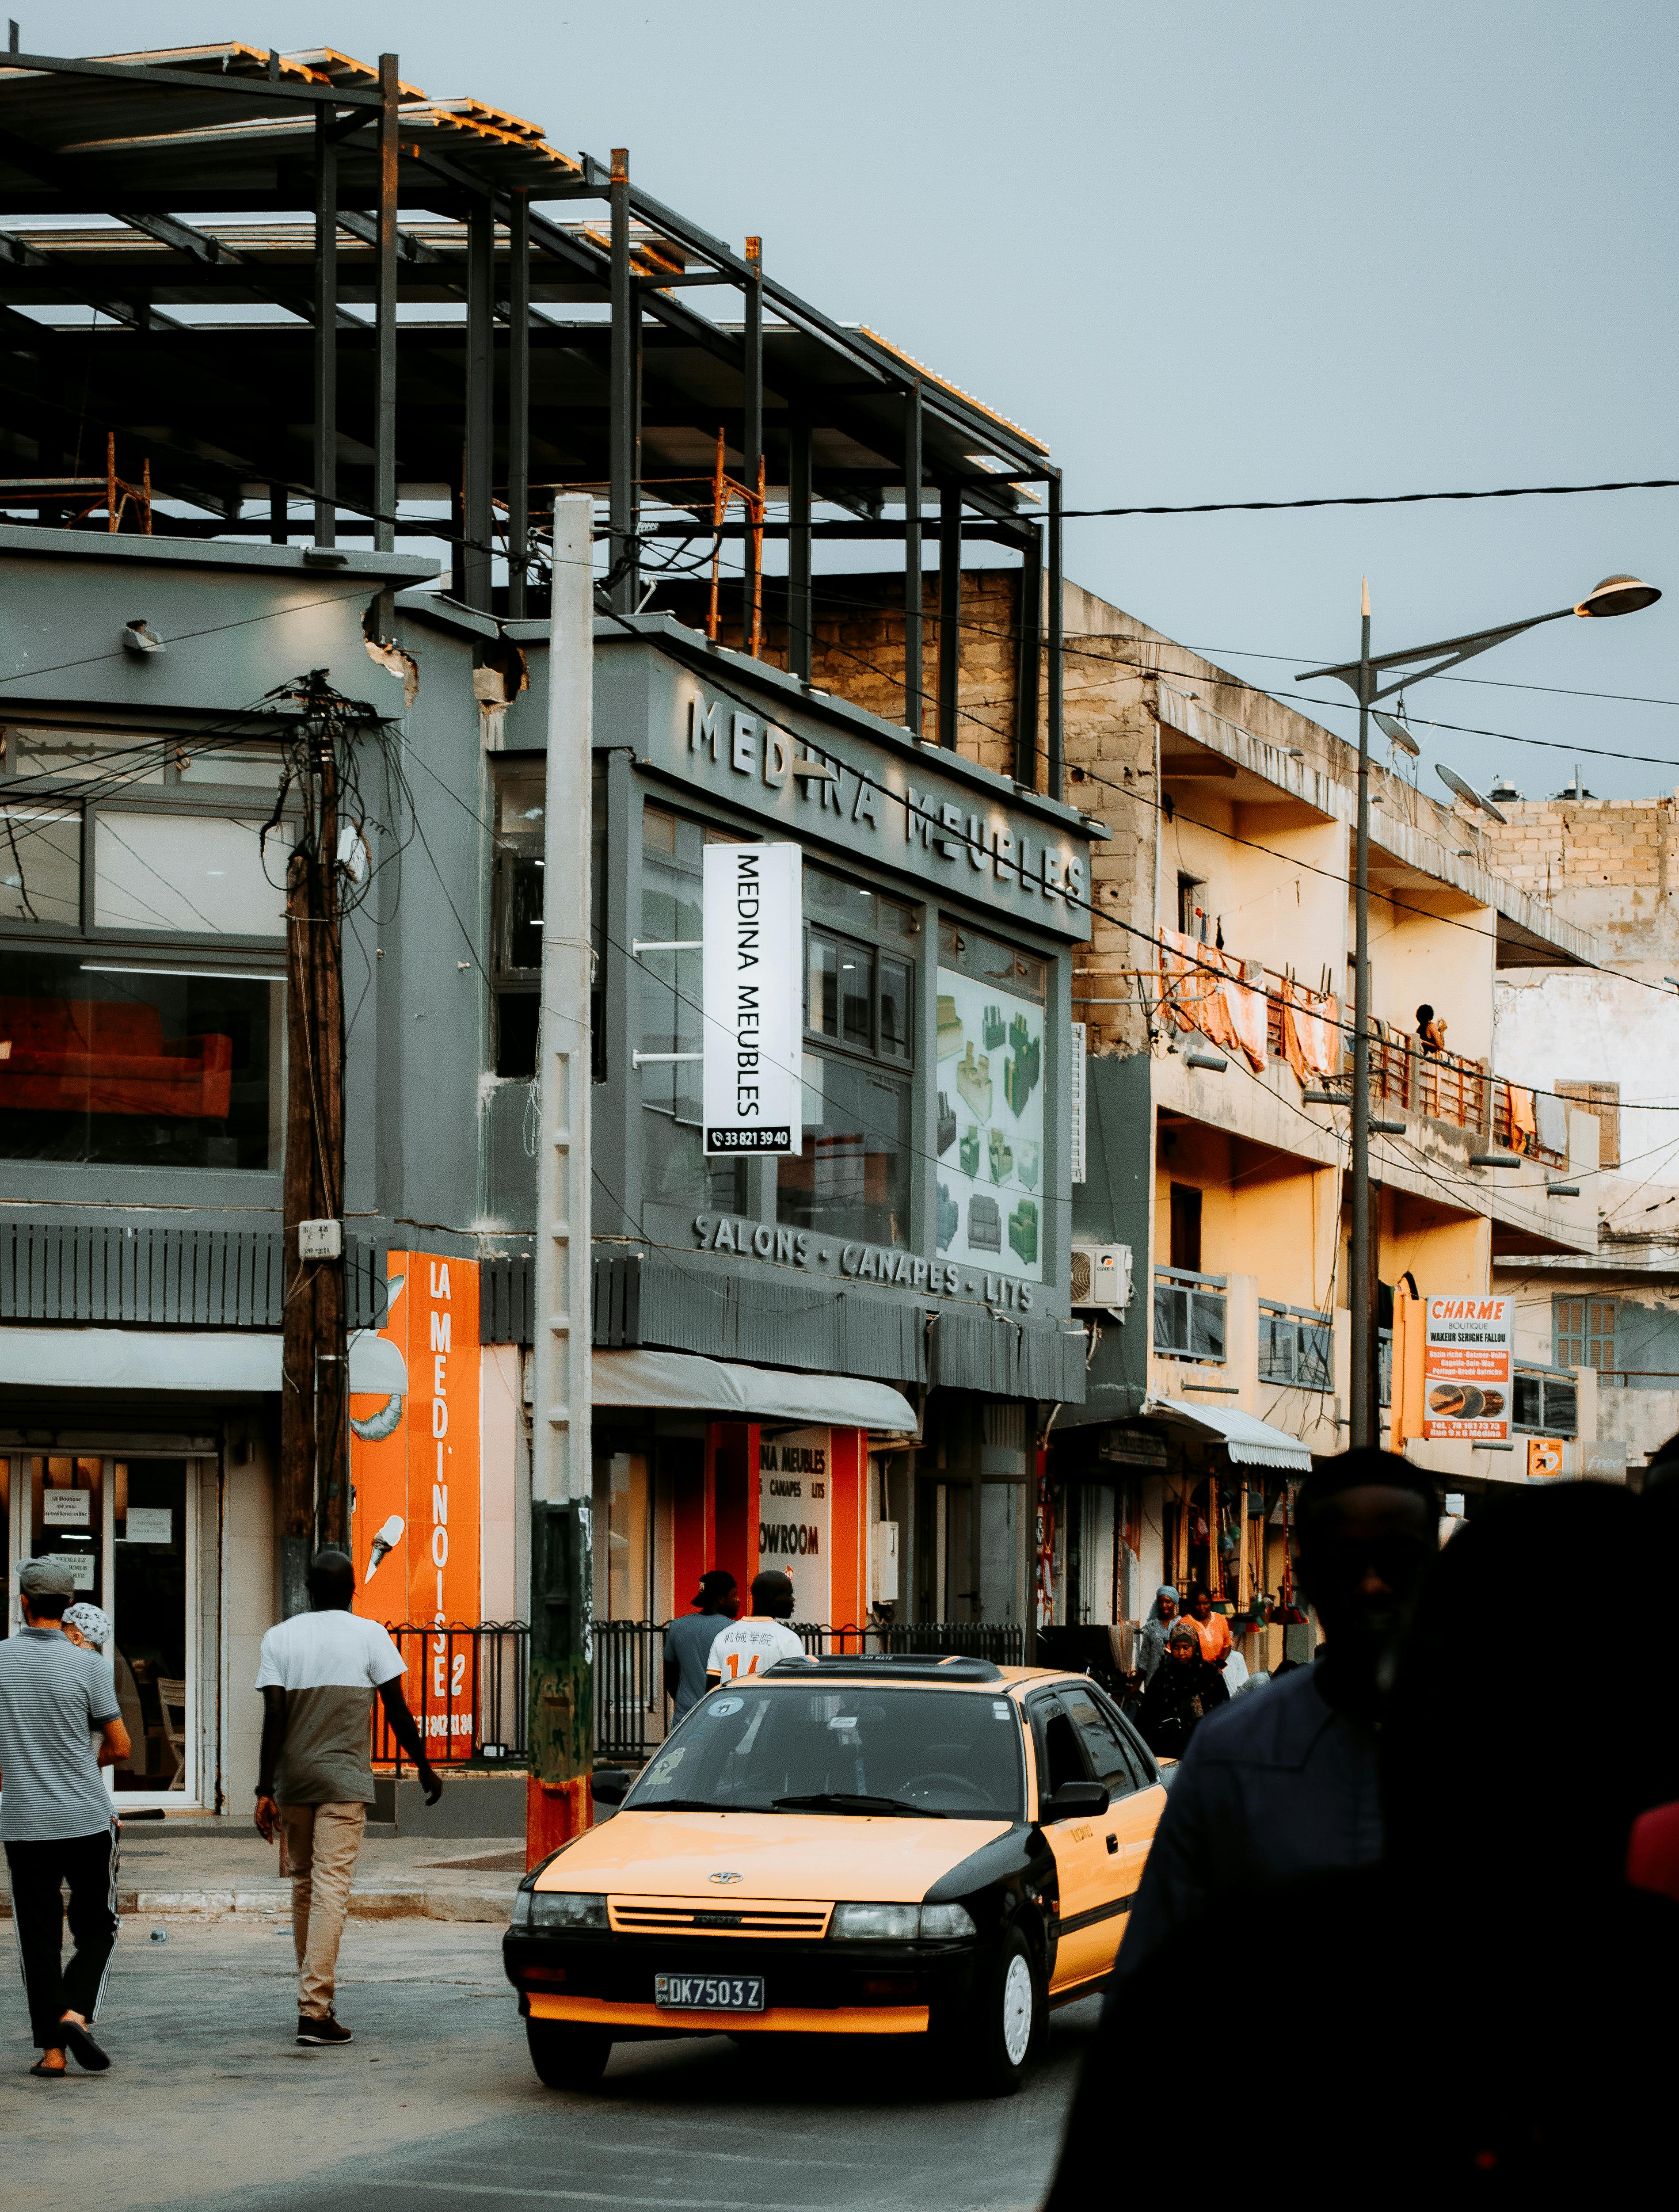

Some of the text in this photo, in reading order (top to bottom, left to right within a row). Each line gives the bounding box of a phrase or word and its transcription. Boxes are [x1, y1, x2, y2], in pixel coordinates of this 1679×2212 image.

[689, 690, 1084, 909] MEDINA MEUBLES
[737, 854, 759, 1117] MEDINA MEUBLES
[725, 1131, 788, 1145] 33 821 39 40
[693, 1214, 809, 1265] SALONS
[841, 1244, 960, 1293] CANAPES
[986, 1275, 1035, 1311] LITS
[1432, 1300, 1506, 1320] CHARME
[1430, 1332, 1506, 1342] WAKEUR SERIGNE FALLOU
[781, 1446, 825, 1475] MEUBLES
[430, 1261, 451, 1301] LA
[451, 1654, 465, 1696] 2
[811, 1482, 825, 1499] LITS
[759, 1522, 819, 1556] OWROOM
